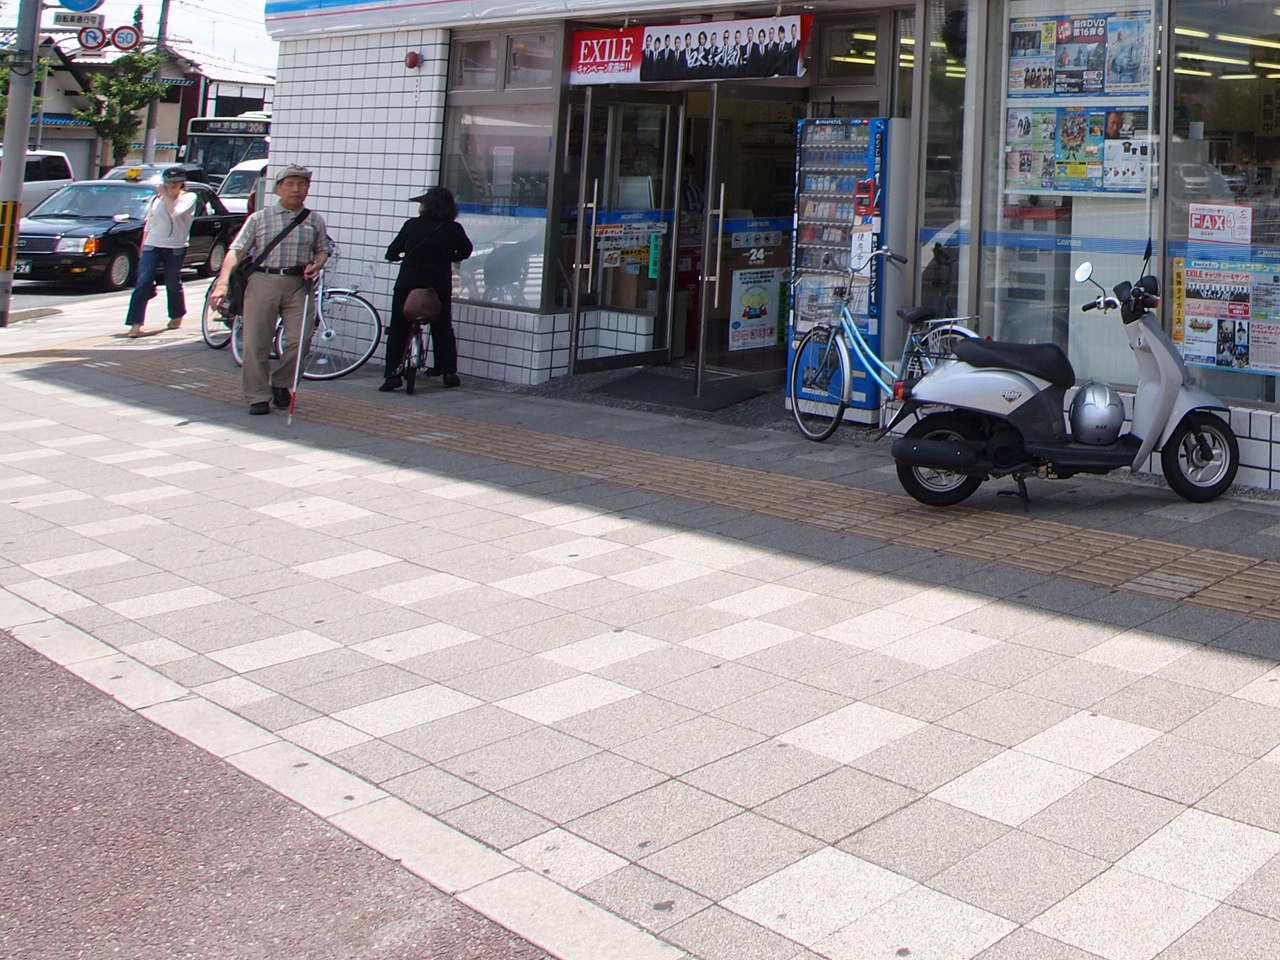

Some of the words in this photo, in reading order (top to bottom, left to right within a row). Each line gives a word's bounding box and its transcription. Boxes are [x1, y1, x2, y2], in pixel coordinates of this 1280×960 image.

[117, 33, 134, 44] 50
[578, 37, 634, 64] EXILE
[1191, 214, 1225, 230] FAX
[749, 249, 765, 260] 24
[1186, 269, 1203, 277] EXILE
